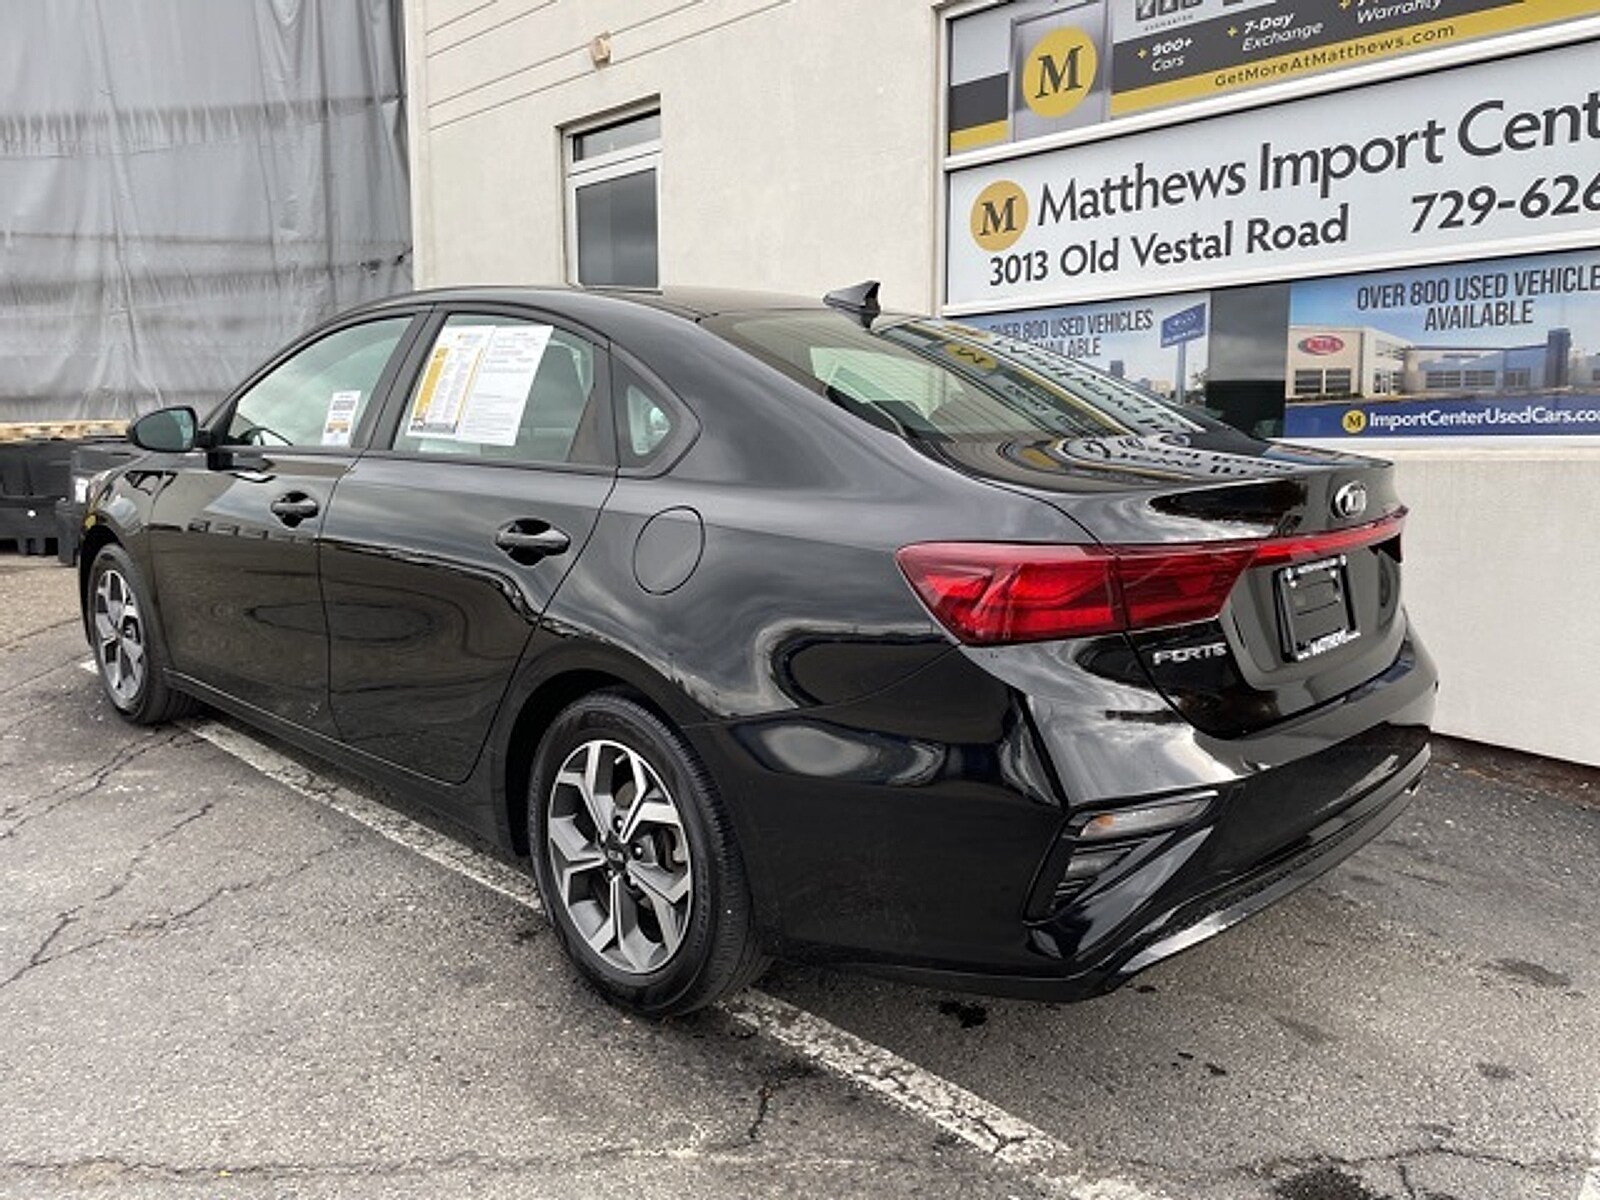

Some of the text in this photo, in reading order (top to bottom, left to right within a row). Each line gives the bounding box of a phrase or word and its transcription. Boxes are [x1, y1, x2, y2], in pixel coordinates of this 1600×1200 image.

[1244, 12, 1294, 34] 7-Day
[1357, 0, 1441, 25] Warranty
[1242, 22, 1324, 51] Exchange
[1035, 45, 1083, 98] M
[1152, 55, 1184, 72] Cars
[1214, 24, 1455, 87] GetMoreAtMatthews.com
[1037, 92, 1600, 226] Matthews Import Cent
[979, 195, 1018, 236] M
[1411, 173, 1600, 233] 729-626
[989, 203, 1348, 286] 3013 Old Vestal Road
[1357, 283, 1405, 310] OVER
[1410, 278, 1449, 305] 800
[1455, 273, 1508, 301] USED
[1023, 319, 1048, 341] 800
[1050, 315, 1083, 338] USED
[1087, 310, 1153, 335] VEHICLES
[1425, 300, 1533, 331] AVAILABLE
[1370, 406, 1600, 431] ImportCenterUsedCars.co
